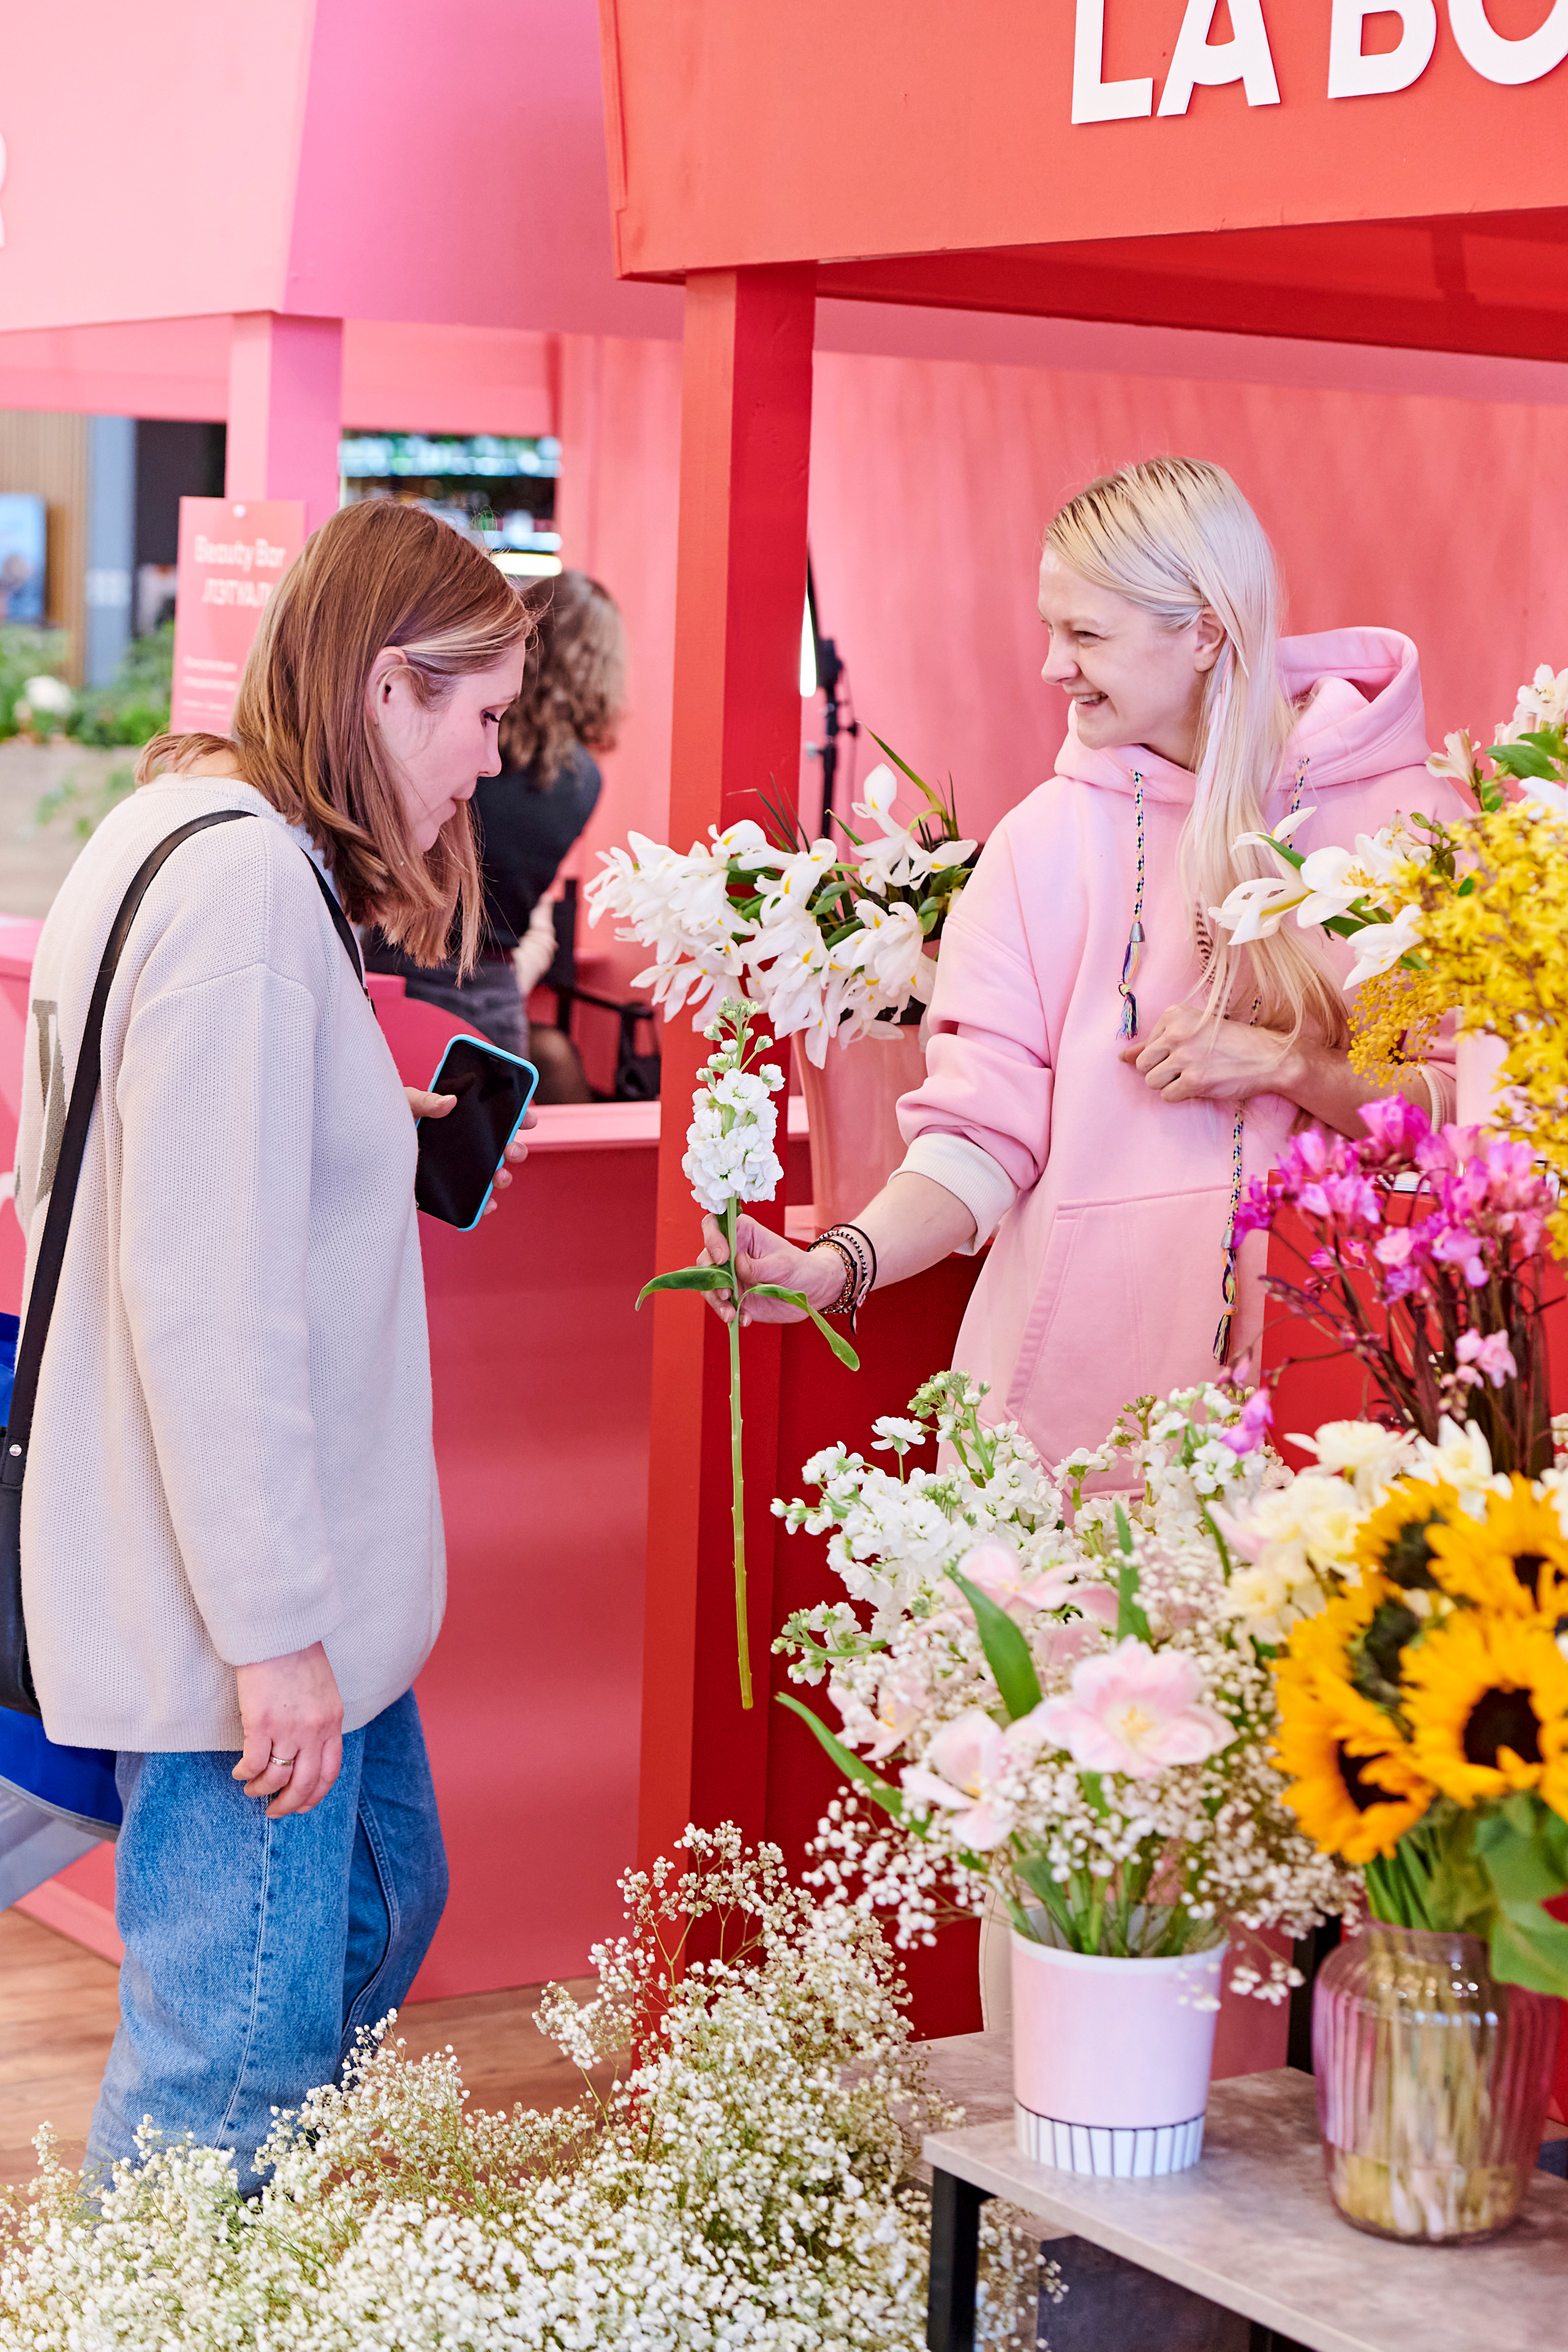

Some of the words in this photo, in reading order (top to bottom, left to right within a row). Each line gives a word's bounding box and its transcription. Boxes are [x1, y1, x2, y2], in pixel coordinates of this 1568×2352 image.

[1071, 0, 1280, 124] LA
[195, 535, 255, 573] Beauty
[255, 538, 287, 568] Bar
